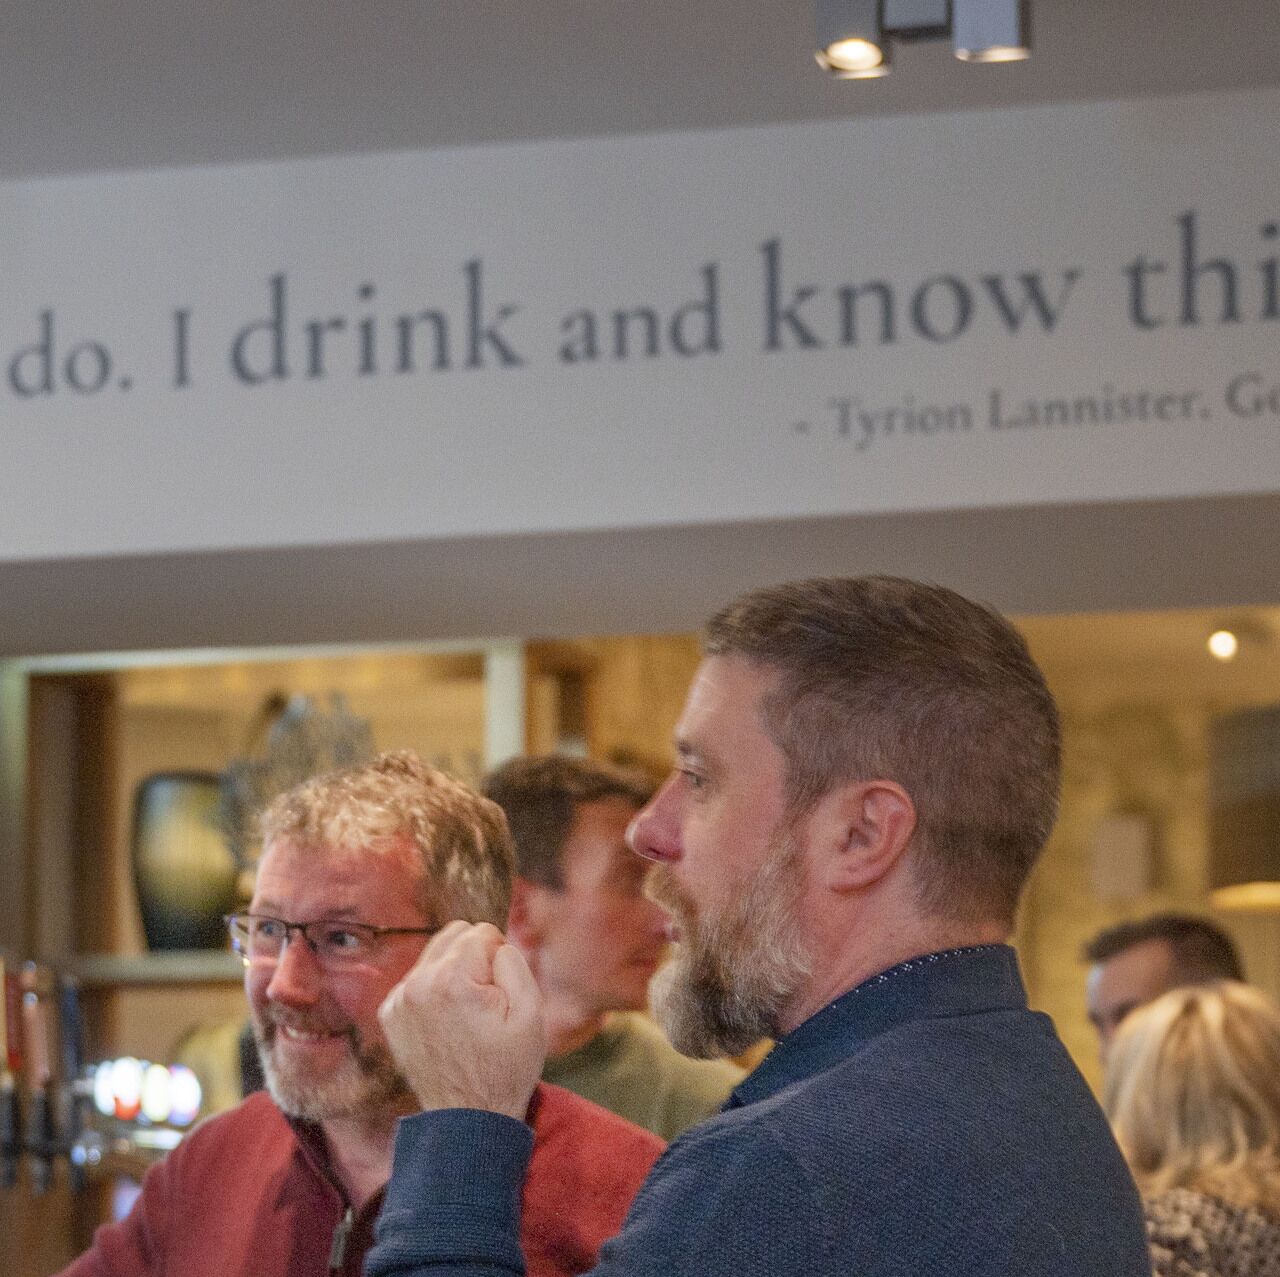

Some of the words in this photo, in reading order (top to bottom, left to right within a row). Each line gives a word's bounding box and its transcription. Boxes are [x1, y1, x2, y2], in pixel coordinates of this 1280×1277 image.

[6, 307, 134, 400] do.
[169, 306, 194, 390] I
[227, 257, 528, 387] drink
[558, 261, 725, 366] and
[758, 236, 1082, 353] know
[830, 396, 973, 452] Tyrion
